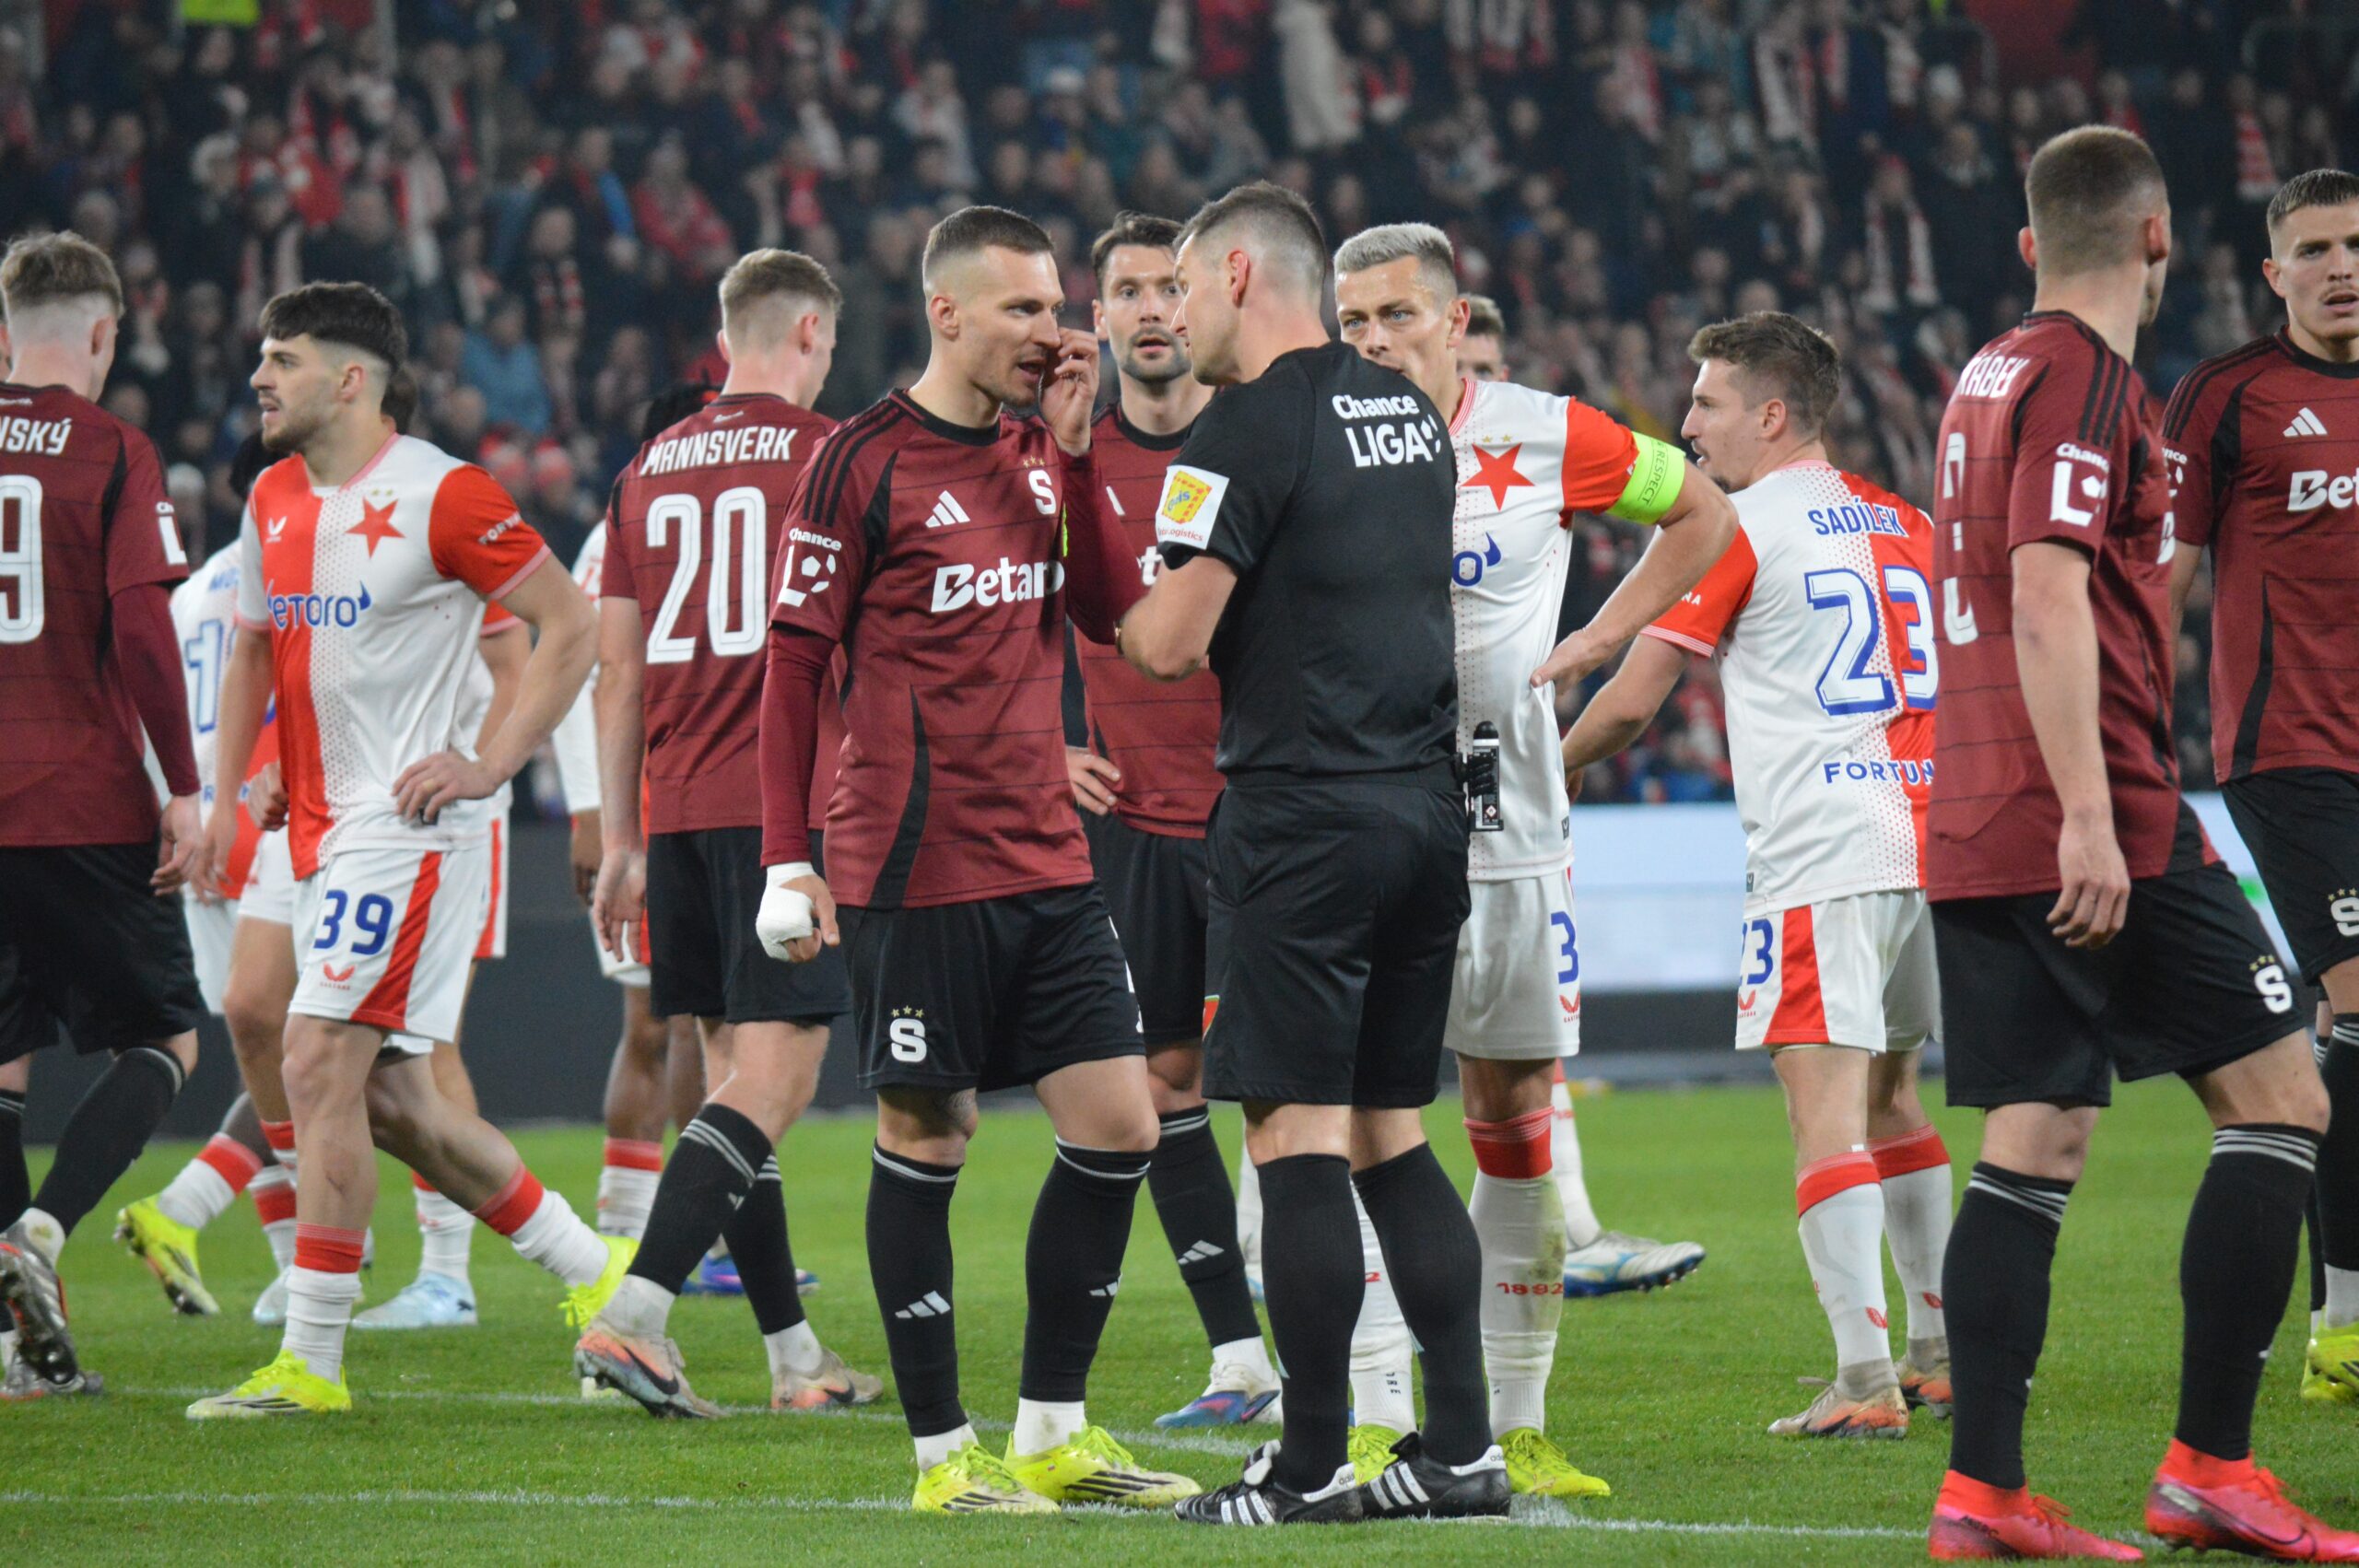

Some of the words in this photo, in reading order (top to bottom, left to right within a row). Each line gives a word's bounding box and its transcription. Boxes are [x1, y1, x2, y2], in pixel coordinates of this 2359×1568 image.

[1332, 394, 1421, 420] Chance
[640, 426, 798, 476] MANNSVERK
[1345, 423, 1433, 468] LIGA
[1027, 469, 1057, 515] S
[1641, 450, 1666, 506] RESPECT
[789, 526, 842, 552] Chance
[1807, 497, 1910, 537] SADÍLEK
[647, 486, 768, 664] 20
[1803, 565, 1939, 717] 23
[312, 889, 394, 956] 39
[1550, 910, 1579, 985] 3
[1738, 918, 1774, 986] 3
[2254, 965, 2293, 1013] S
[890, 1018, 927, 1063] S
[1496, 1281, 1564, 1295] 1892
